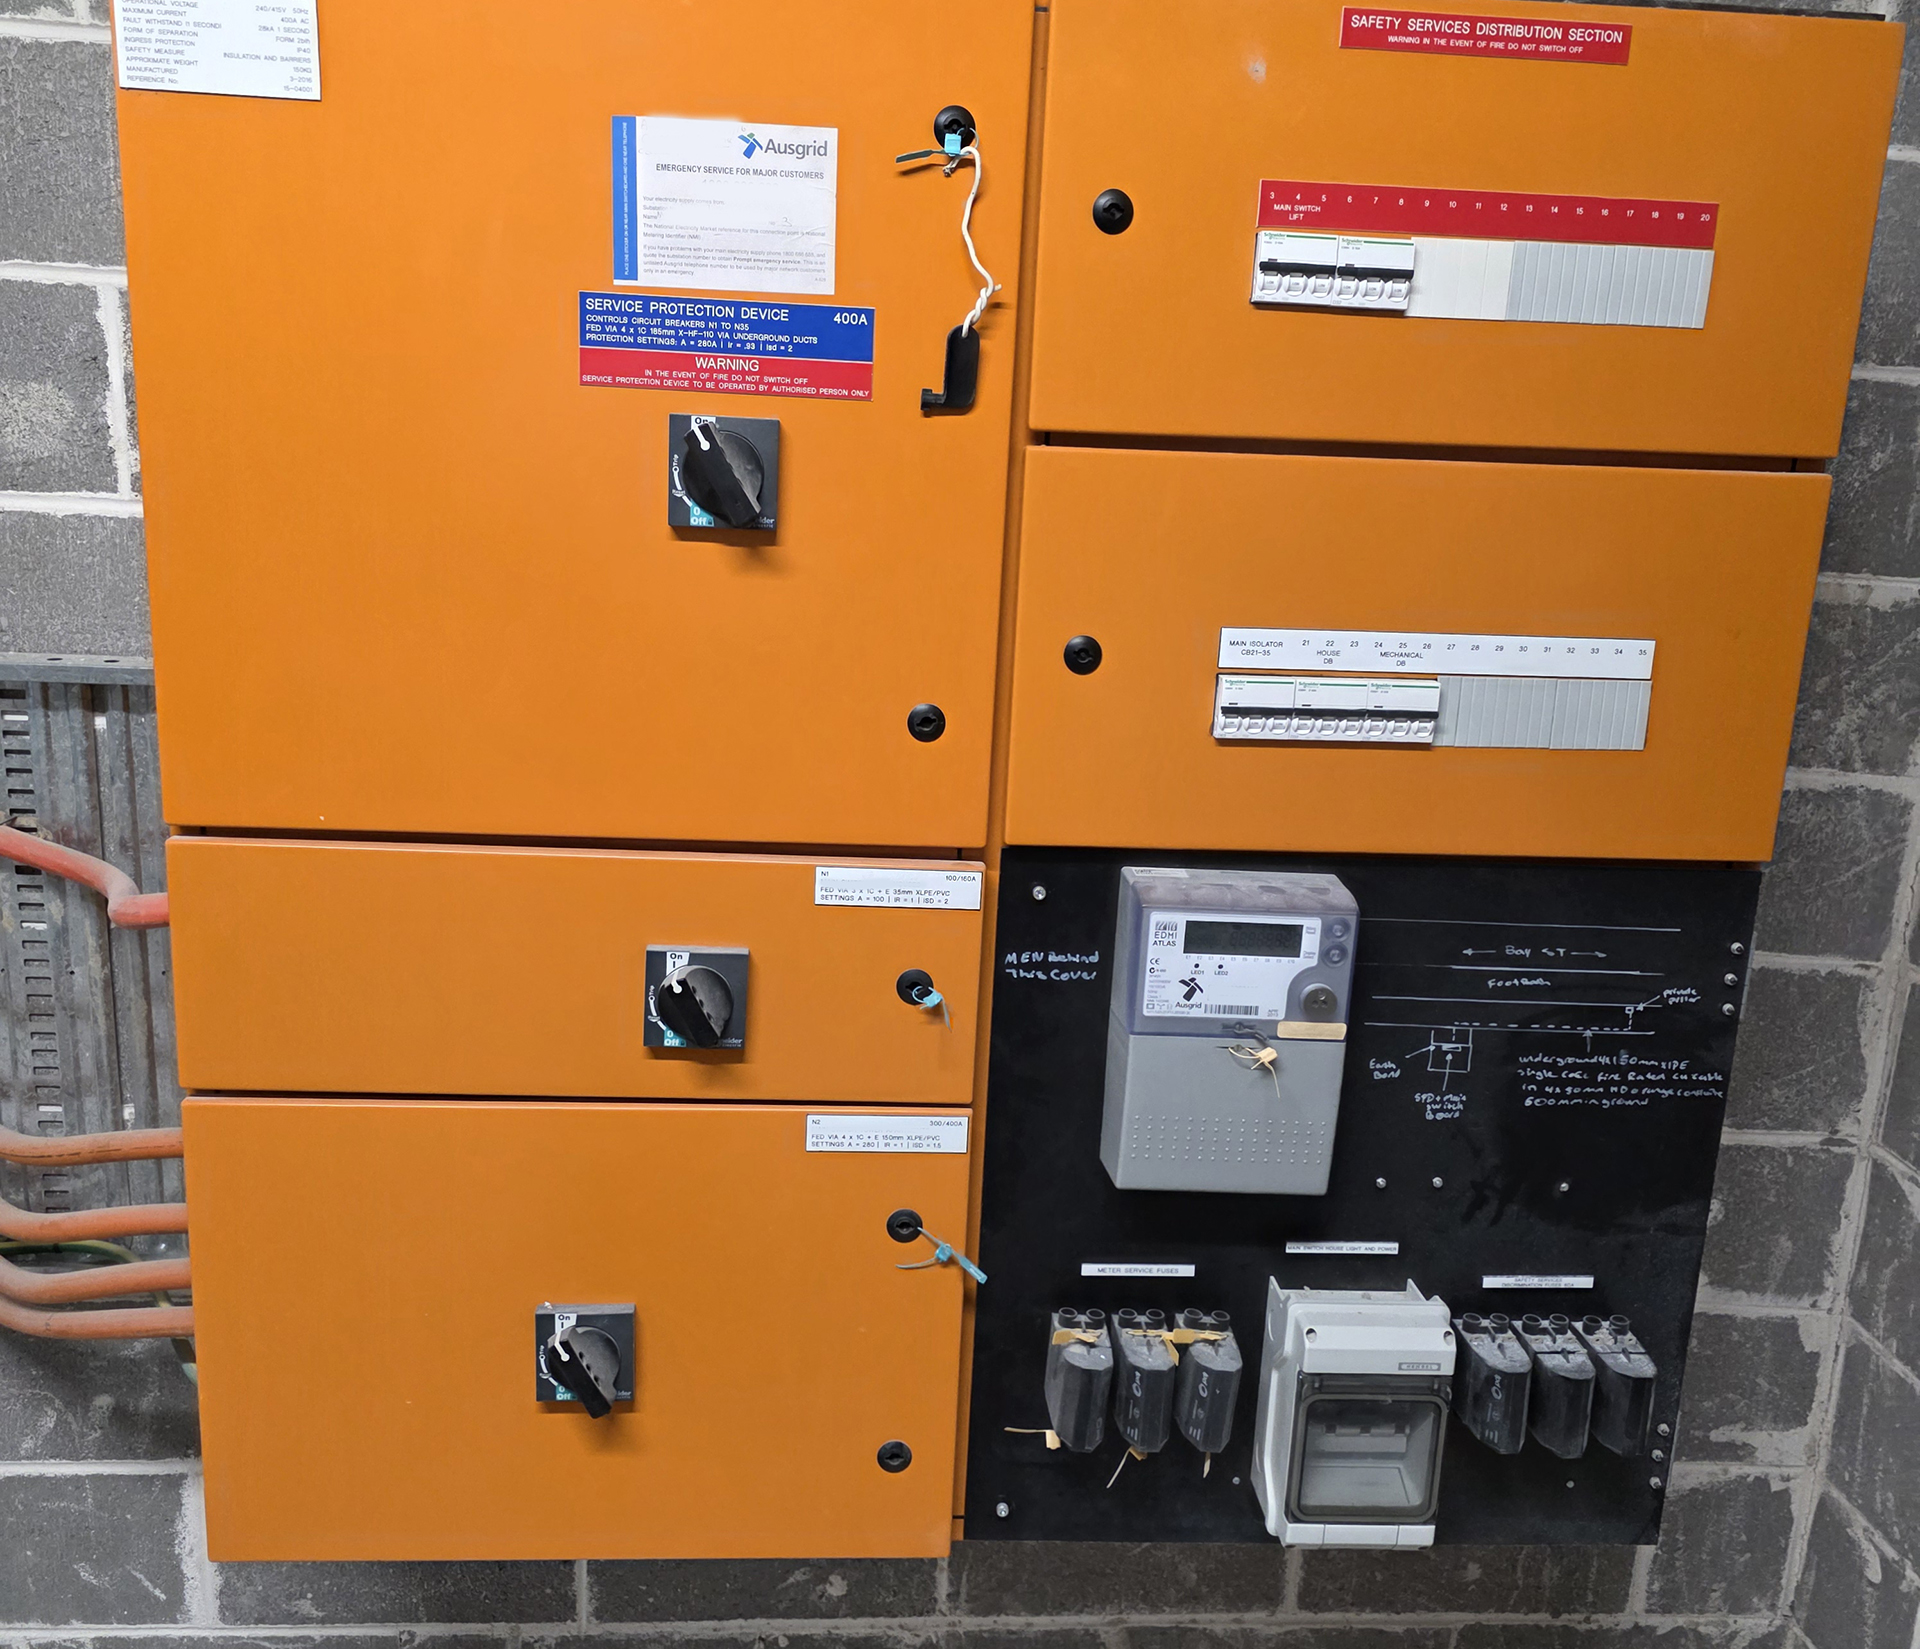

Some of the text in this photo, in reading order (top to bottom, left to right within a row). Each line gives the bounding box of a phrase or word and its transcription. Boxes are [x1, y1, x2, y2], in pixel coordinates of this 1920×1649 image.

[121, 6, 154, 14] MAXIMUM
[1350, 14, 1623, 43] SAFETY SERVICES DISTRIBUTION SECTION
[1387, 35, 1420, 44] WARNING
[1433, 37, 1447, 45] THE
[1449, 38, 1474, 47] EVENT
[1489, 41, 1505, 49] FIRE
[1538, 44, 1566, 52] SWITCH
[153, 47, 185, 56] MEASURE
[222, 52, 261, 60] INSULATION
[279, 55, 311, 64] BARRIERS
[764, 138, 828, 160] Ausgrid
[655, 163, 824, 179] EMERGENCY SERVICE FOR MAJOR CUSTOMERS
[1269, 191, 1275, 199] 3
[1321, 194, 1327, 202] 5
[1346, 195, 1352, 203] 6
[1398, 198, 1404, 206] 8
[1424, 199, 1430, 207] 9
[1448, 200, 1457, 208] 10
[1500, 203, 1508, 211] 12
[1525, 204, 1533, 212] 13
[1576, 207, 1584, 215] 15
[1601, 208, 1609, 216] 16
[1651, 210, 1659, 218] 18
[1676, 212, 1685, 220] 19
[1700, 213, 1710, 221] 20
[585, 297, 789, 321] SERVICE PROTECTION DEVICE
[585, 313, 628, 324] CONTROLS
[631, 316, 662, 325] CIRCUIT
[664, 318, 705, 328] BREAKERS
[720, 321, 731, 330] TO
[734, 322, 750, 331] N35
[833, 312, 868, 325] 400A
[585, 323, 818, 344] FED VIA 1C 185mm X-HF-110 VIA UNDERGROUND DUCTS
[585, 332, 634, 343] PROTECTION
[636, 335, 677, 345] SETTINGS:
[697, 339, 717, 348] 280A
[694, 356, 759, 371] WARNING
[655, 369, 669, 377] THE
[672, 370, 696, 378] EVENT
[712, 372, 728, 381] FIRE
[763, 375, 791, 384] SWITCH
[582, 374, 613, 383] SERVICE
[615, 376, 661, 385] PROTECTION
[662, 378, 689, 387] DEVICE
[692, 380, 703, 388] TO
[718, 382, 756, 390] OPERATED
[771, 385, 817, 394] AUTHORISED
[819, 387, 848, 396] PERSON
[850, 389, 869, 397] ONLY
[690, 517, 707, 525] Off
[1240, 648, 1271, 656] CB21-35
[1154, 931, 1178, 940] EDMI
[1004, 952, 1044, 964] MEN
